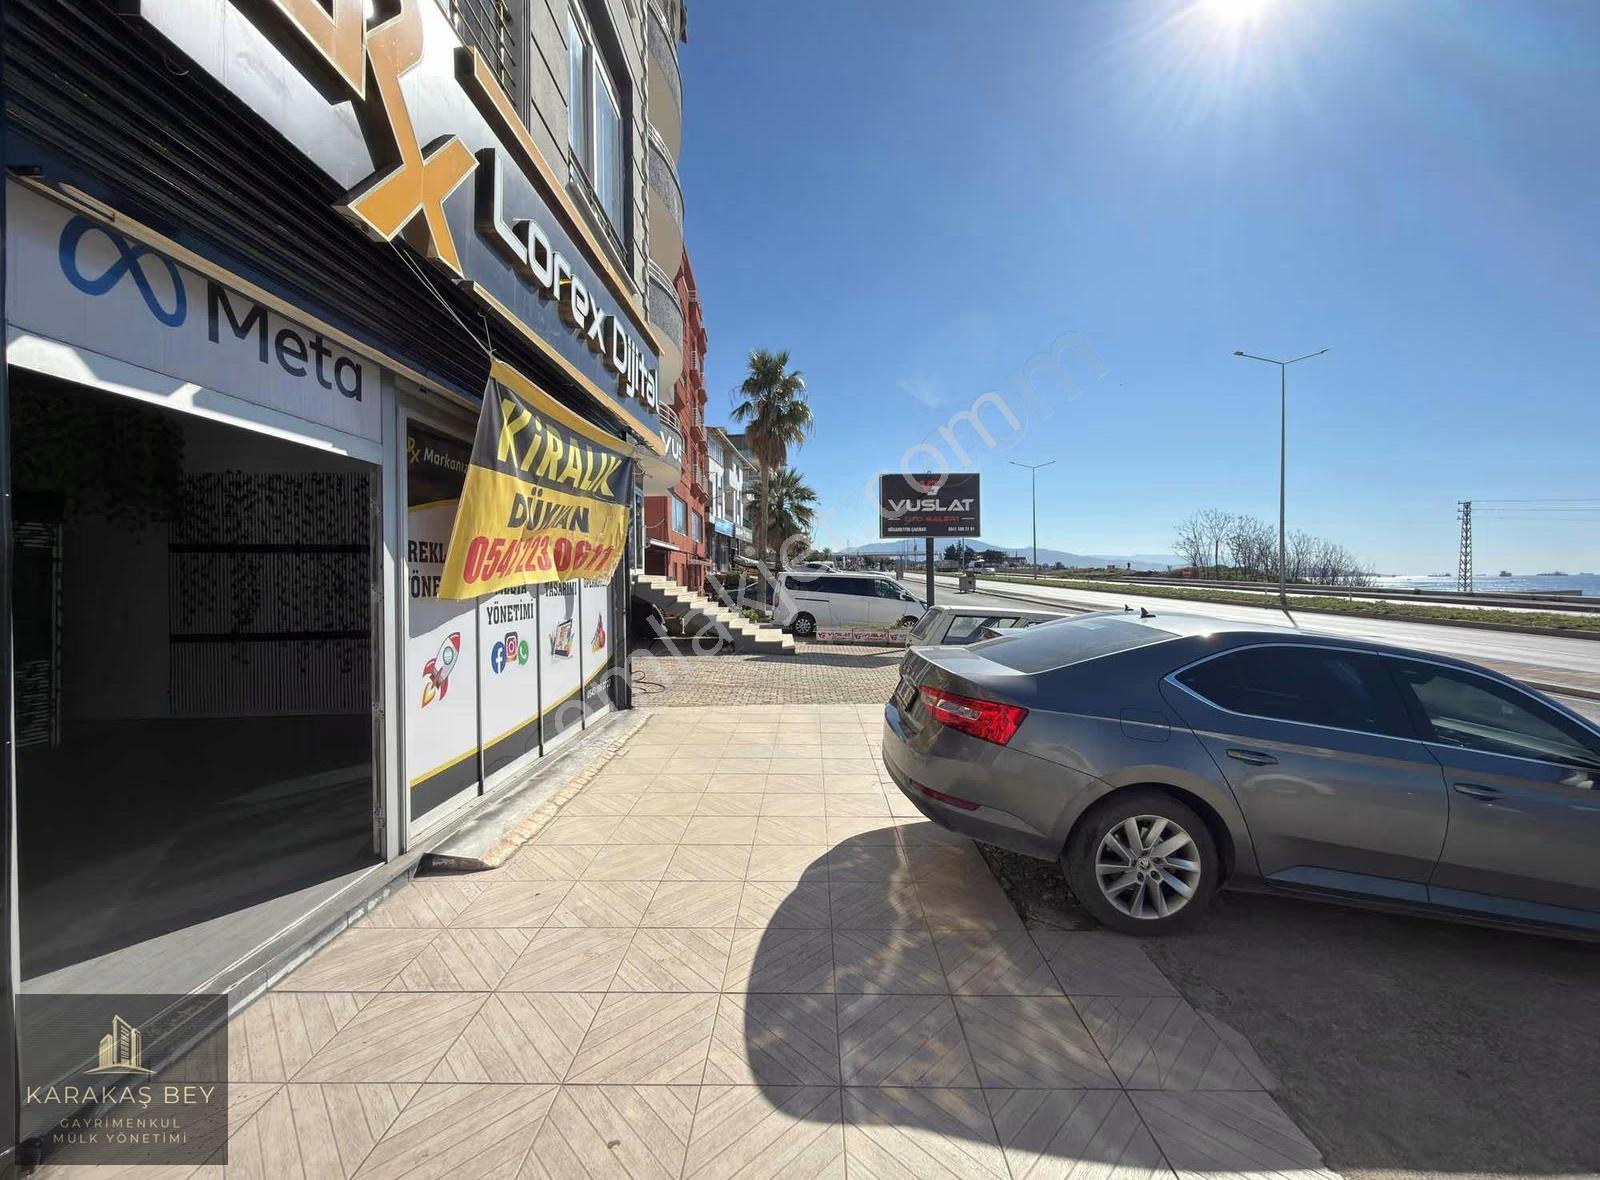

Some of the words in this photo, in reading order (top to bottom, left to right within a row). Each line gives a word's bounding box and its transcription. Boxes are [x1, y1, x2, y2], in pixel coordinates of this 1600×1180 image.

[490, 152, 606, 354] Lorex
[611, 315, 660, 413] Dijital
[207, 284, 364, 403] Meta
[887, 498, 975, 512] VUSLAT
[486, 599, 534, 625] YÖNETİMİ
